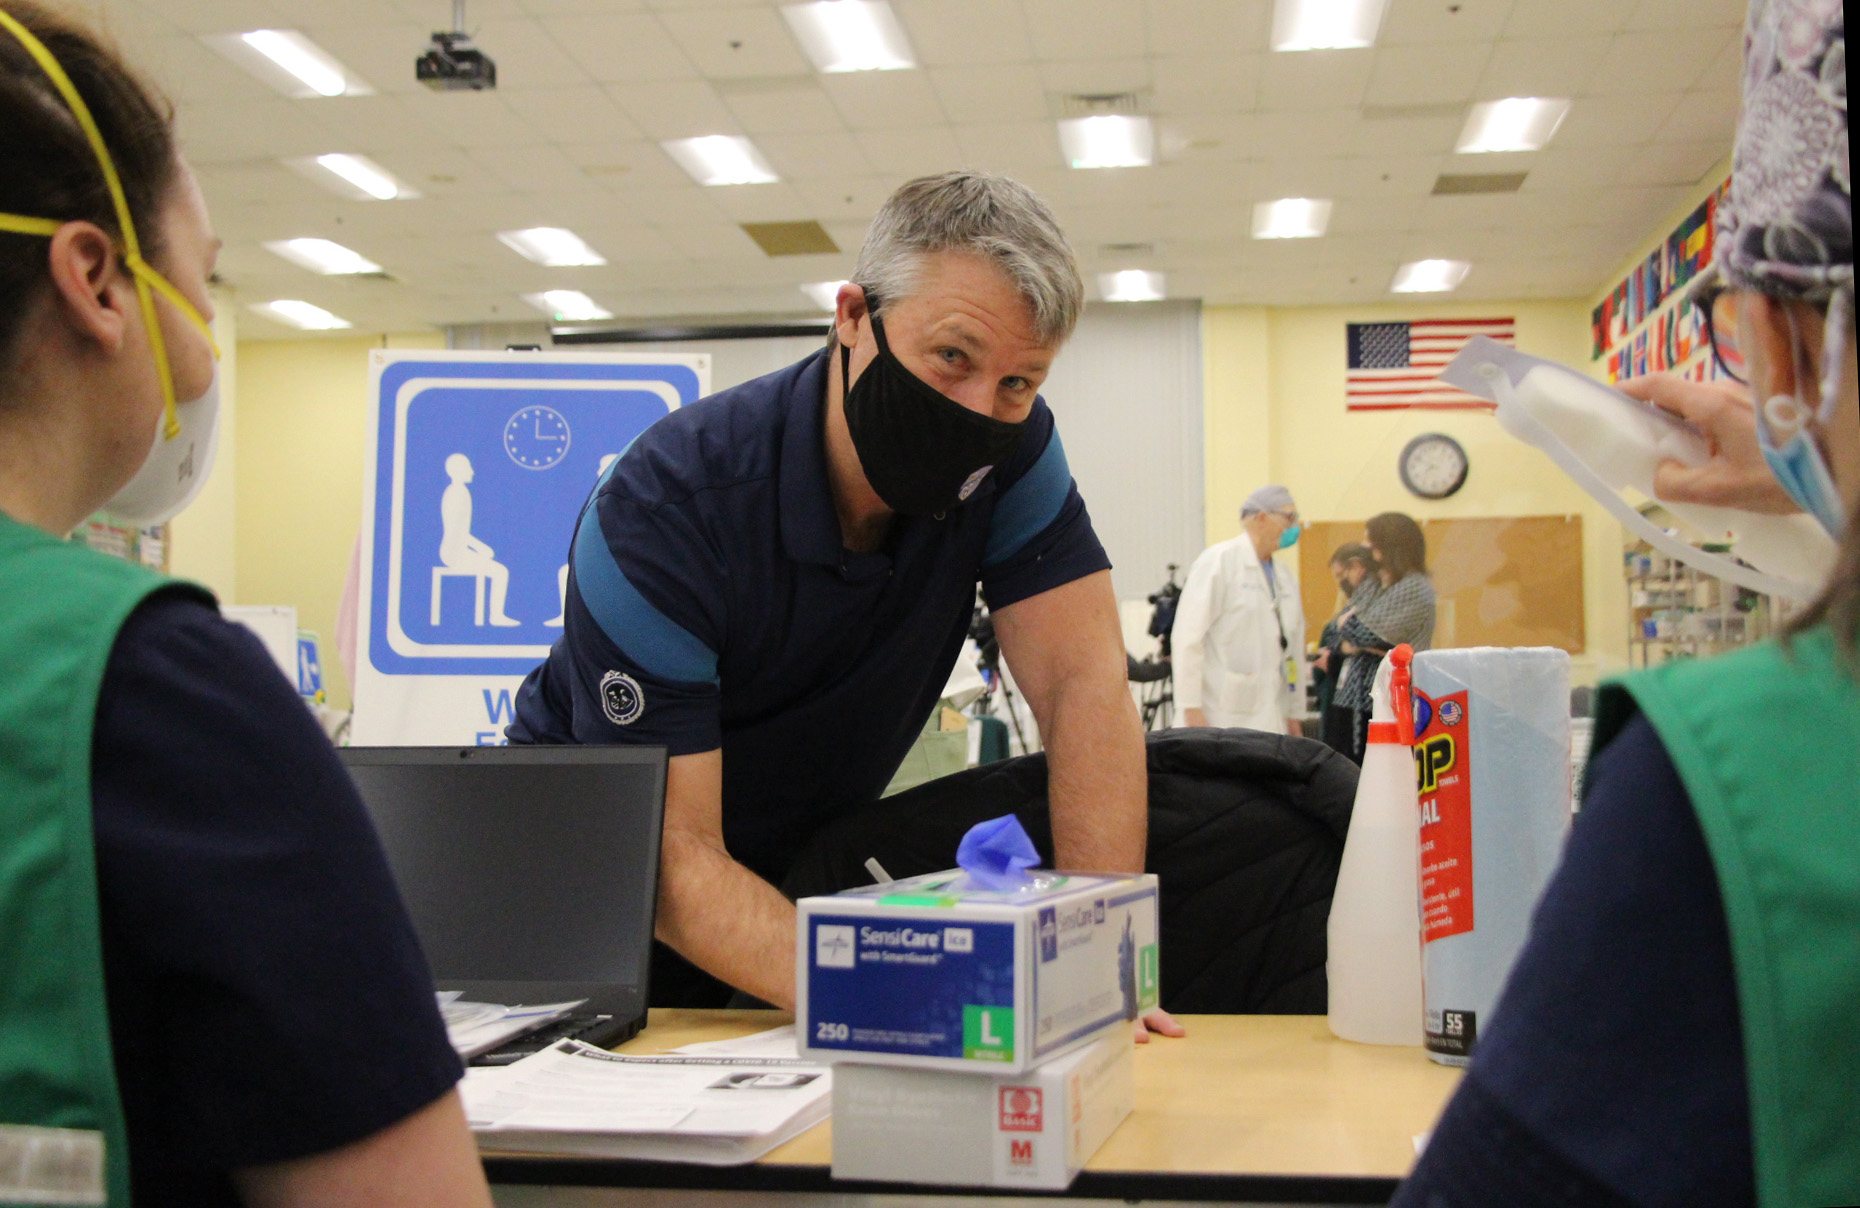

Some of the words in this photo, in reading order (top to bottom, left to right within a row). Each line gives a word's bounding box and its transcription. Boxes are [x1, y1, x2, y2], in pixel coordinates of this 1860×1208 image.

[1439, 775, 1459, 787] TOWELS
[860, 926, 940, 948] SensiCare
[1144, 951, 1153, 988] L
[981, 1011, 1002, 1045] L
[1446, 1013, 1463, 1030] 55
[817, 1022, 849, 1041] 250
[585, 1051, 611, 1061] What
[1011, 1140, 1032, 1158] M
